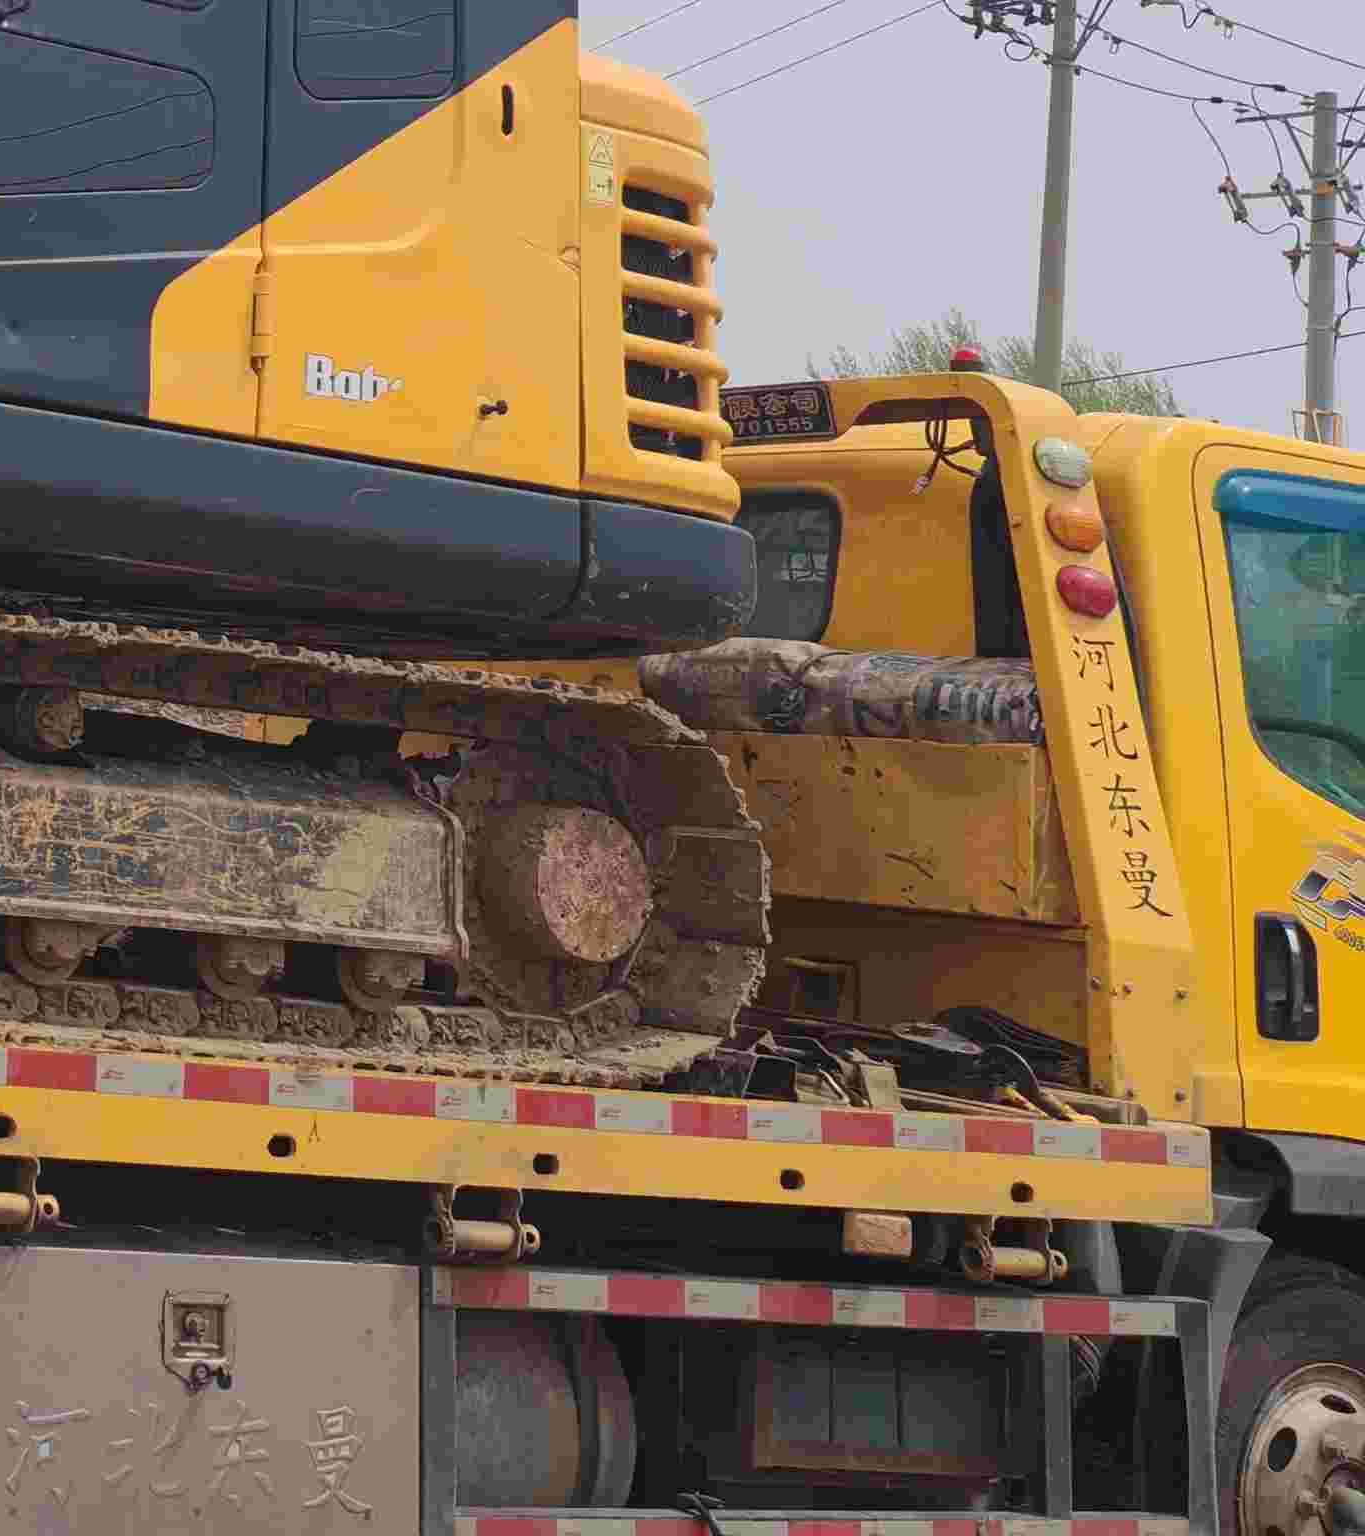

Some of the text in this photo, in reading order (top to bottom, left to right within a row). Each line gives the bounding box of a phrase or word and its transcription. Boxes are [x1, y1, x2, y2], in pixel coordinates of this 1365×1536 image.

[721, 390, 820, 419] 限公司
[1071, 635, 1173, 917] 河北东曼
